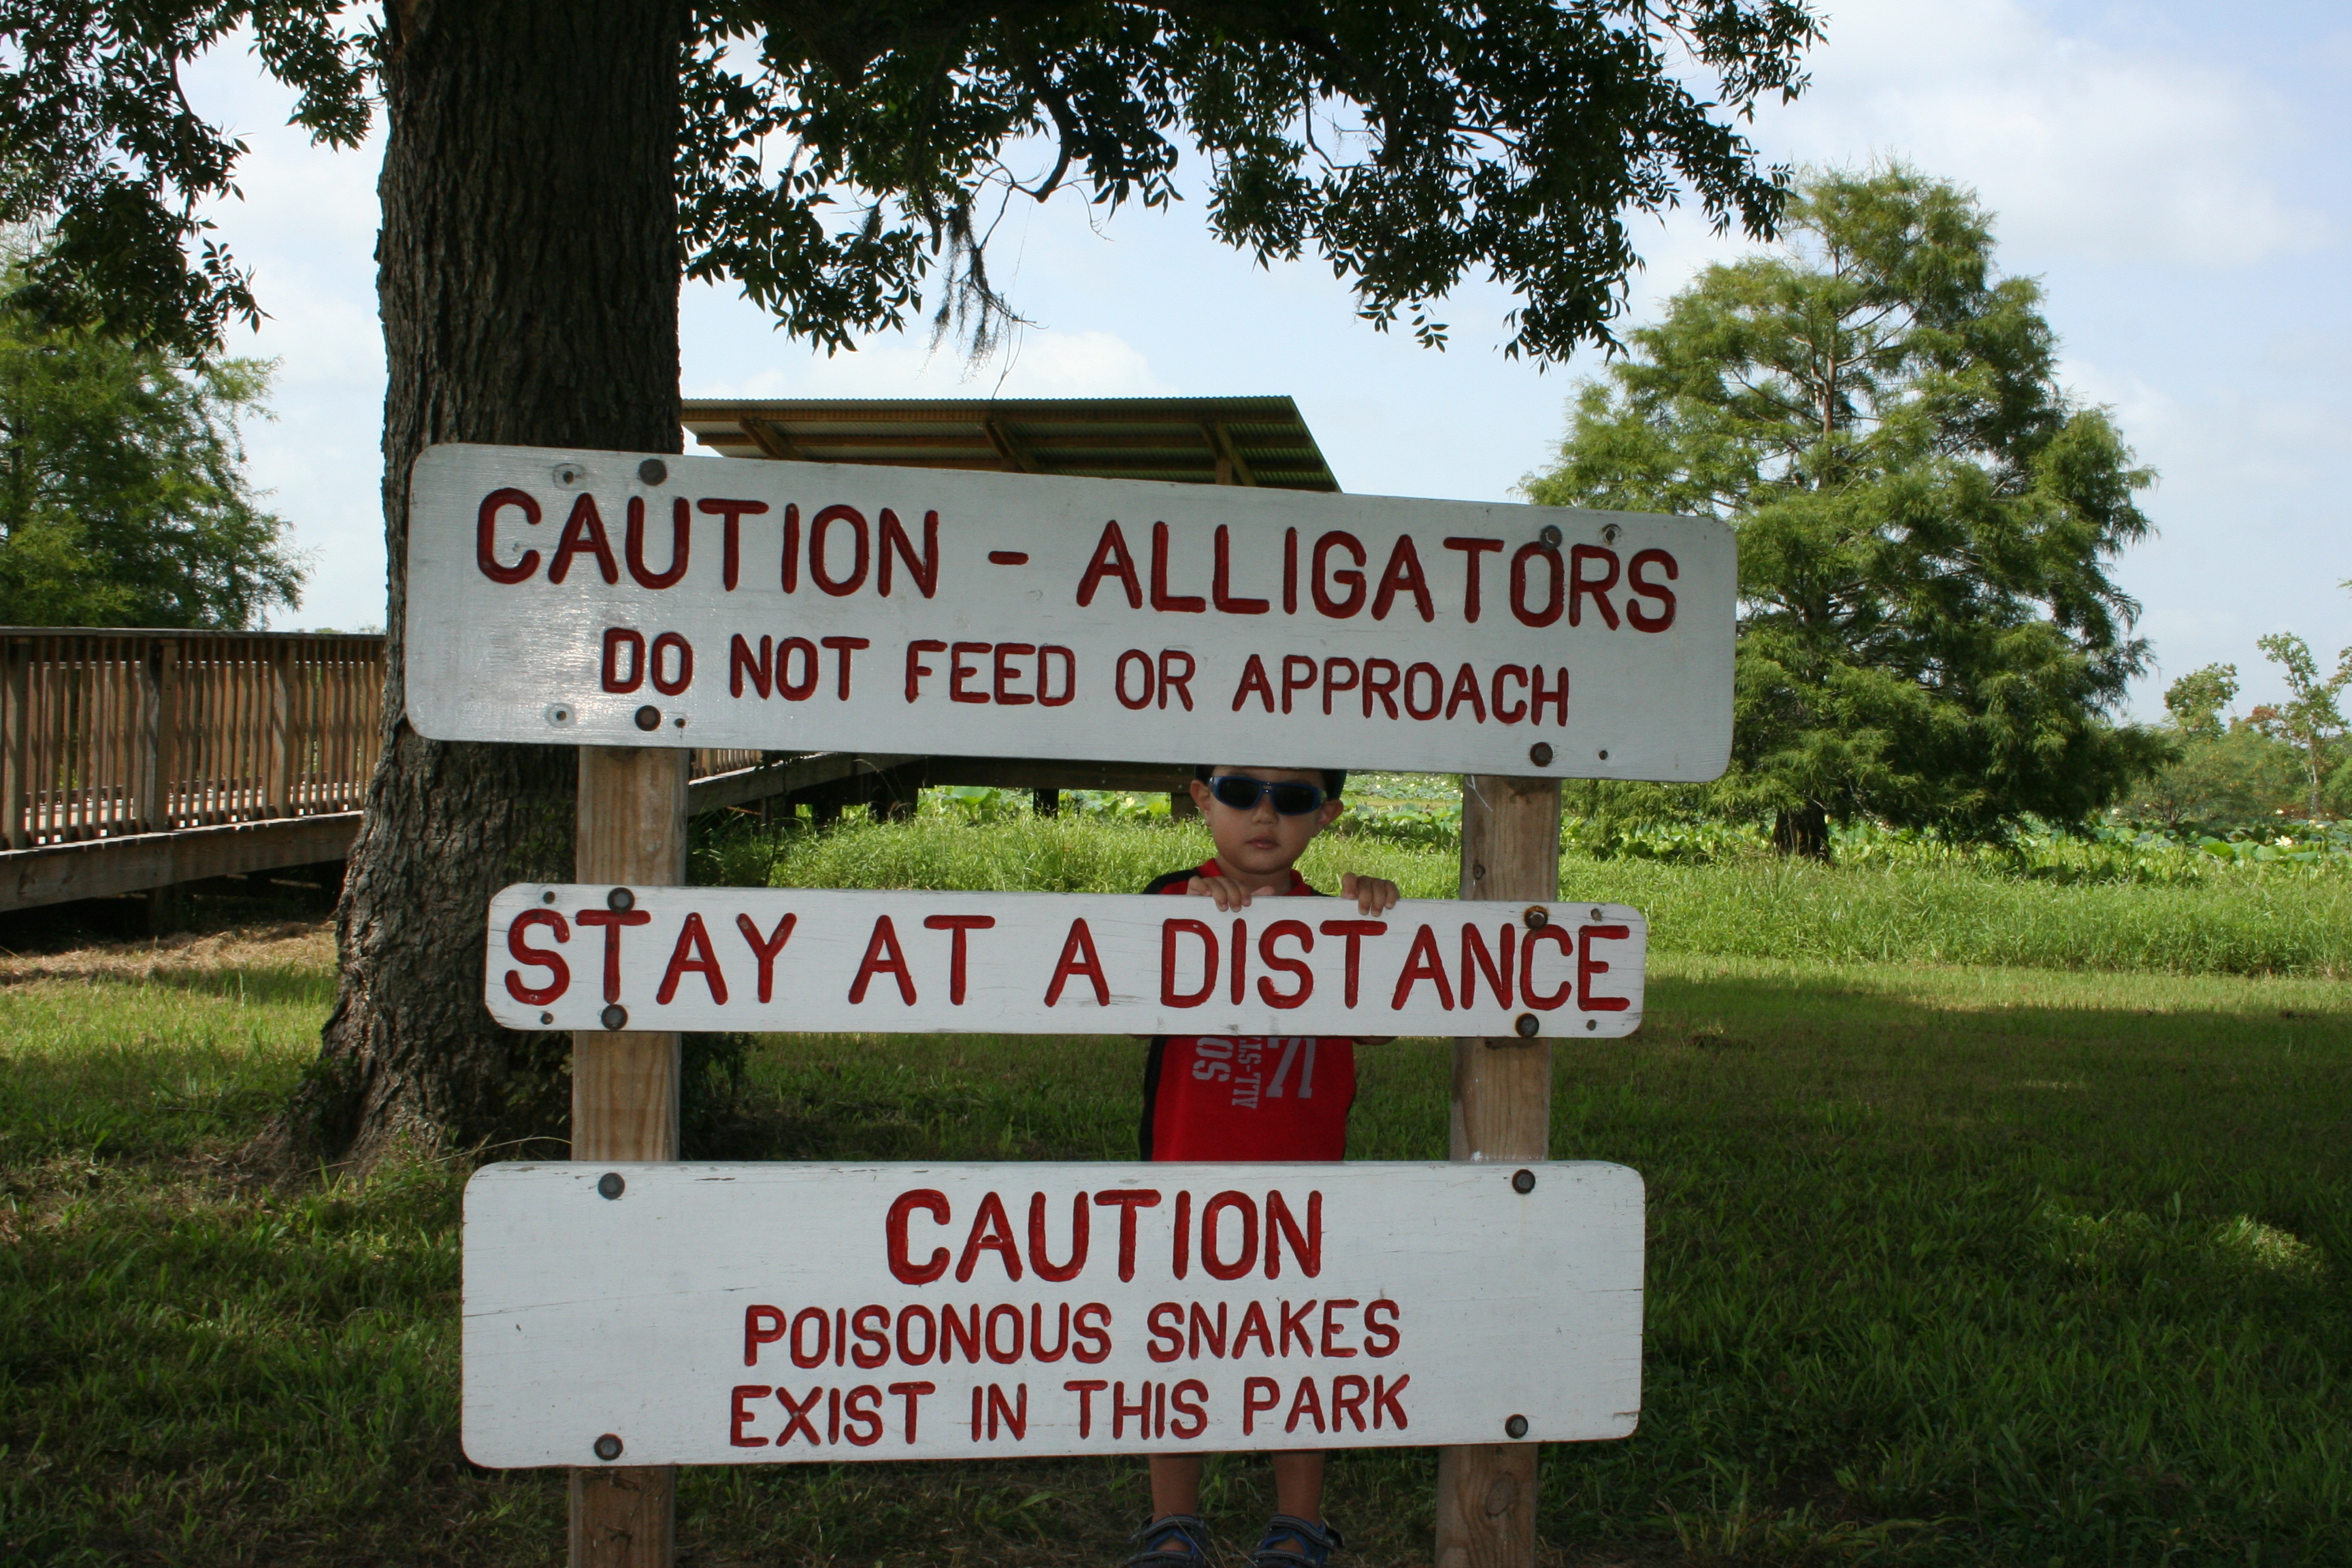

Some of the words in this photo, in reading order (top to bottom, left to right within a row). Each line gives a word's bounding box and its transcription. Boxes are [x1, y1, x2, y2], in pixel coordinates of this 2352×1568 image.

[477, 487, 939, 600] CAUTION
[987, 550, 1030, 566] -
[1076, 519, 1679, 634] ALLIGATORS
[602, 626, 694, 697] DO
[730, 633, 871, 702] NOT
[905, 638, 1076, 708] FEED
[1115, 648, 1196, 711] OR
[1232, 653, 1569, 728] APPROACH
[504, 908, 798, 1007] STAY
[848, 913, 996, 1007] AT
[1044, 917, 1111, 1008] A
[1160, 917, 1632, 1013] DISTANCE
[885, 1188, 1323, 1286] CAUTION
[744, 1303, 1113, 1370] POISONOUS
[1147, 1297, 1401, 1364] SNAKES
[730, 1380, 937, 1449] EXIST
[971, 1382, 1028, 1442] IN
[1063, 1378, 1209, 1440] THIS
[1243, 1373, 1411, 1437] PARK
